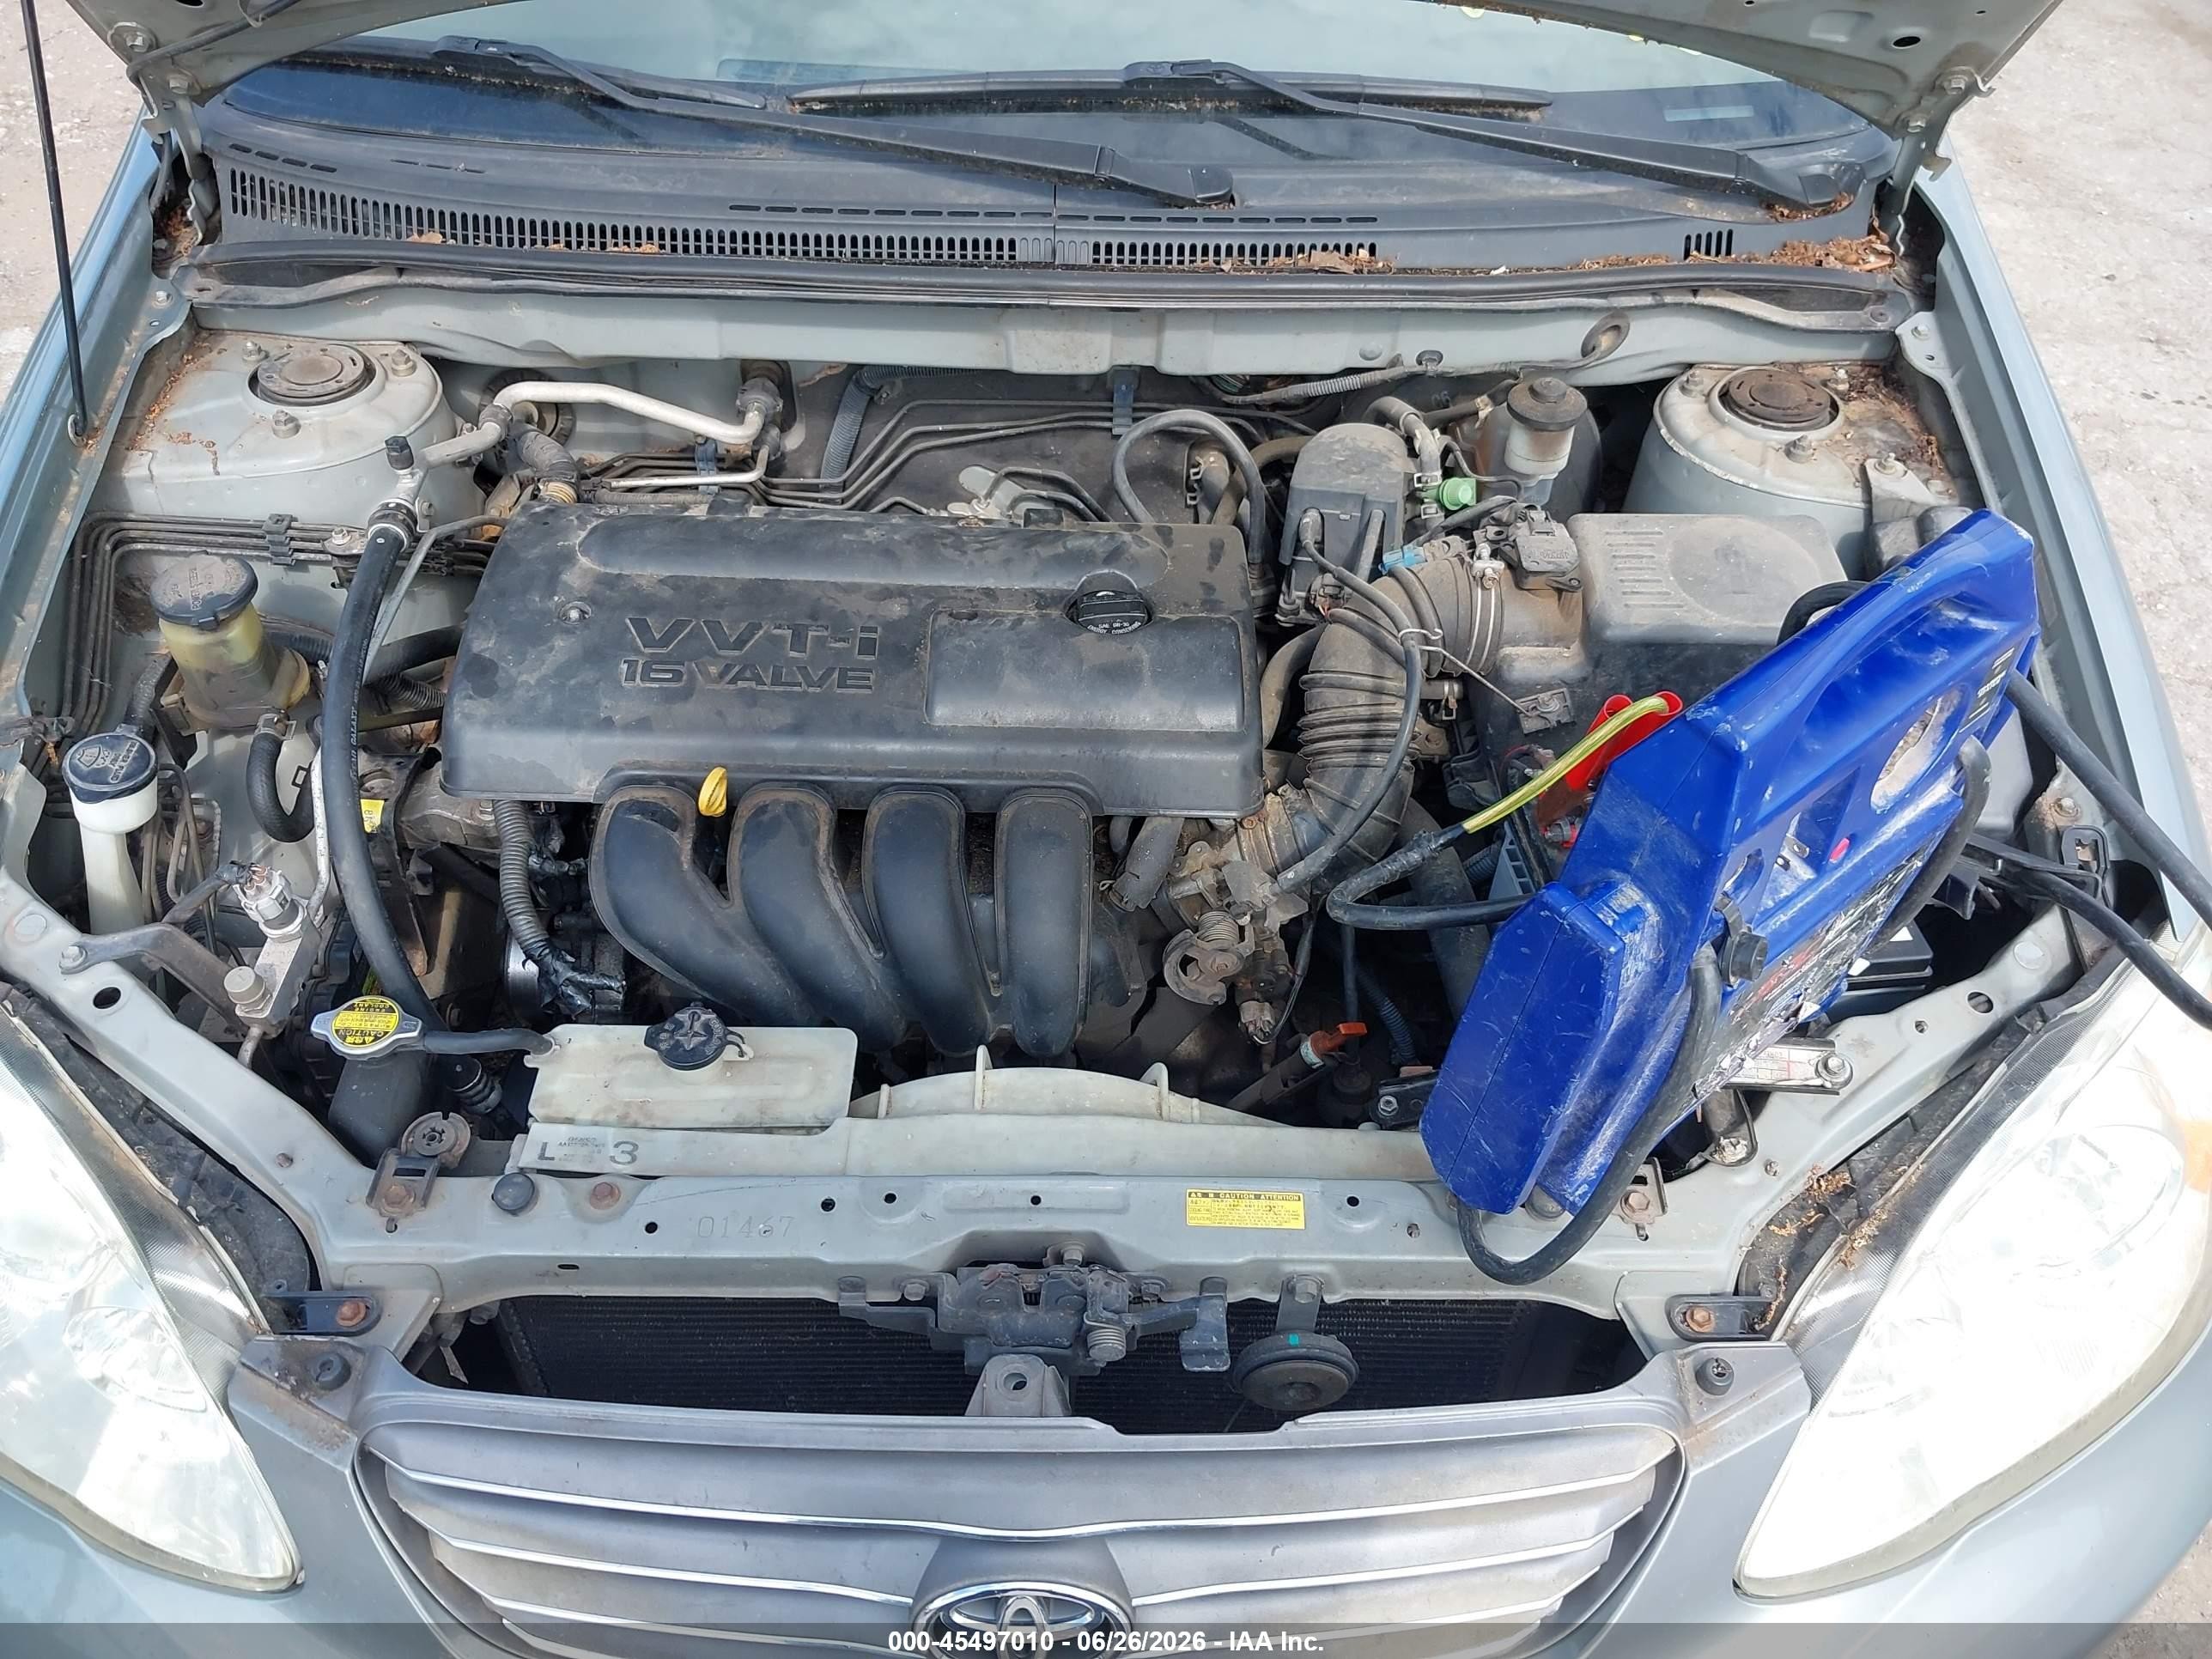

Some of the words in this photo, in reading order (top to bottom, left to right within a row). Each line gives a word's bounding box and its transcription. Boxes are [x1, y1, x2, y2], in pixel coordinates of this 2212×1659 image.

[625, 617, 880, 659] VVT-i
[620, 658, 686, 687] 16
[692, 660, 874, 692] VALVE
[538, 1142, 556, 1161] L
[609, 1140, 640, 1166] 3
